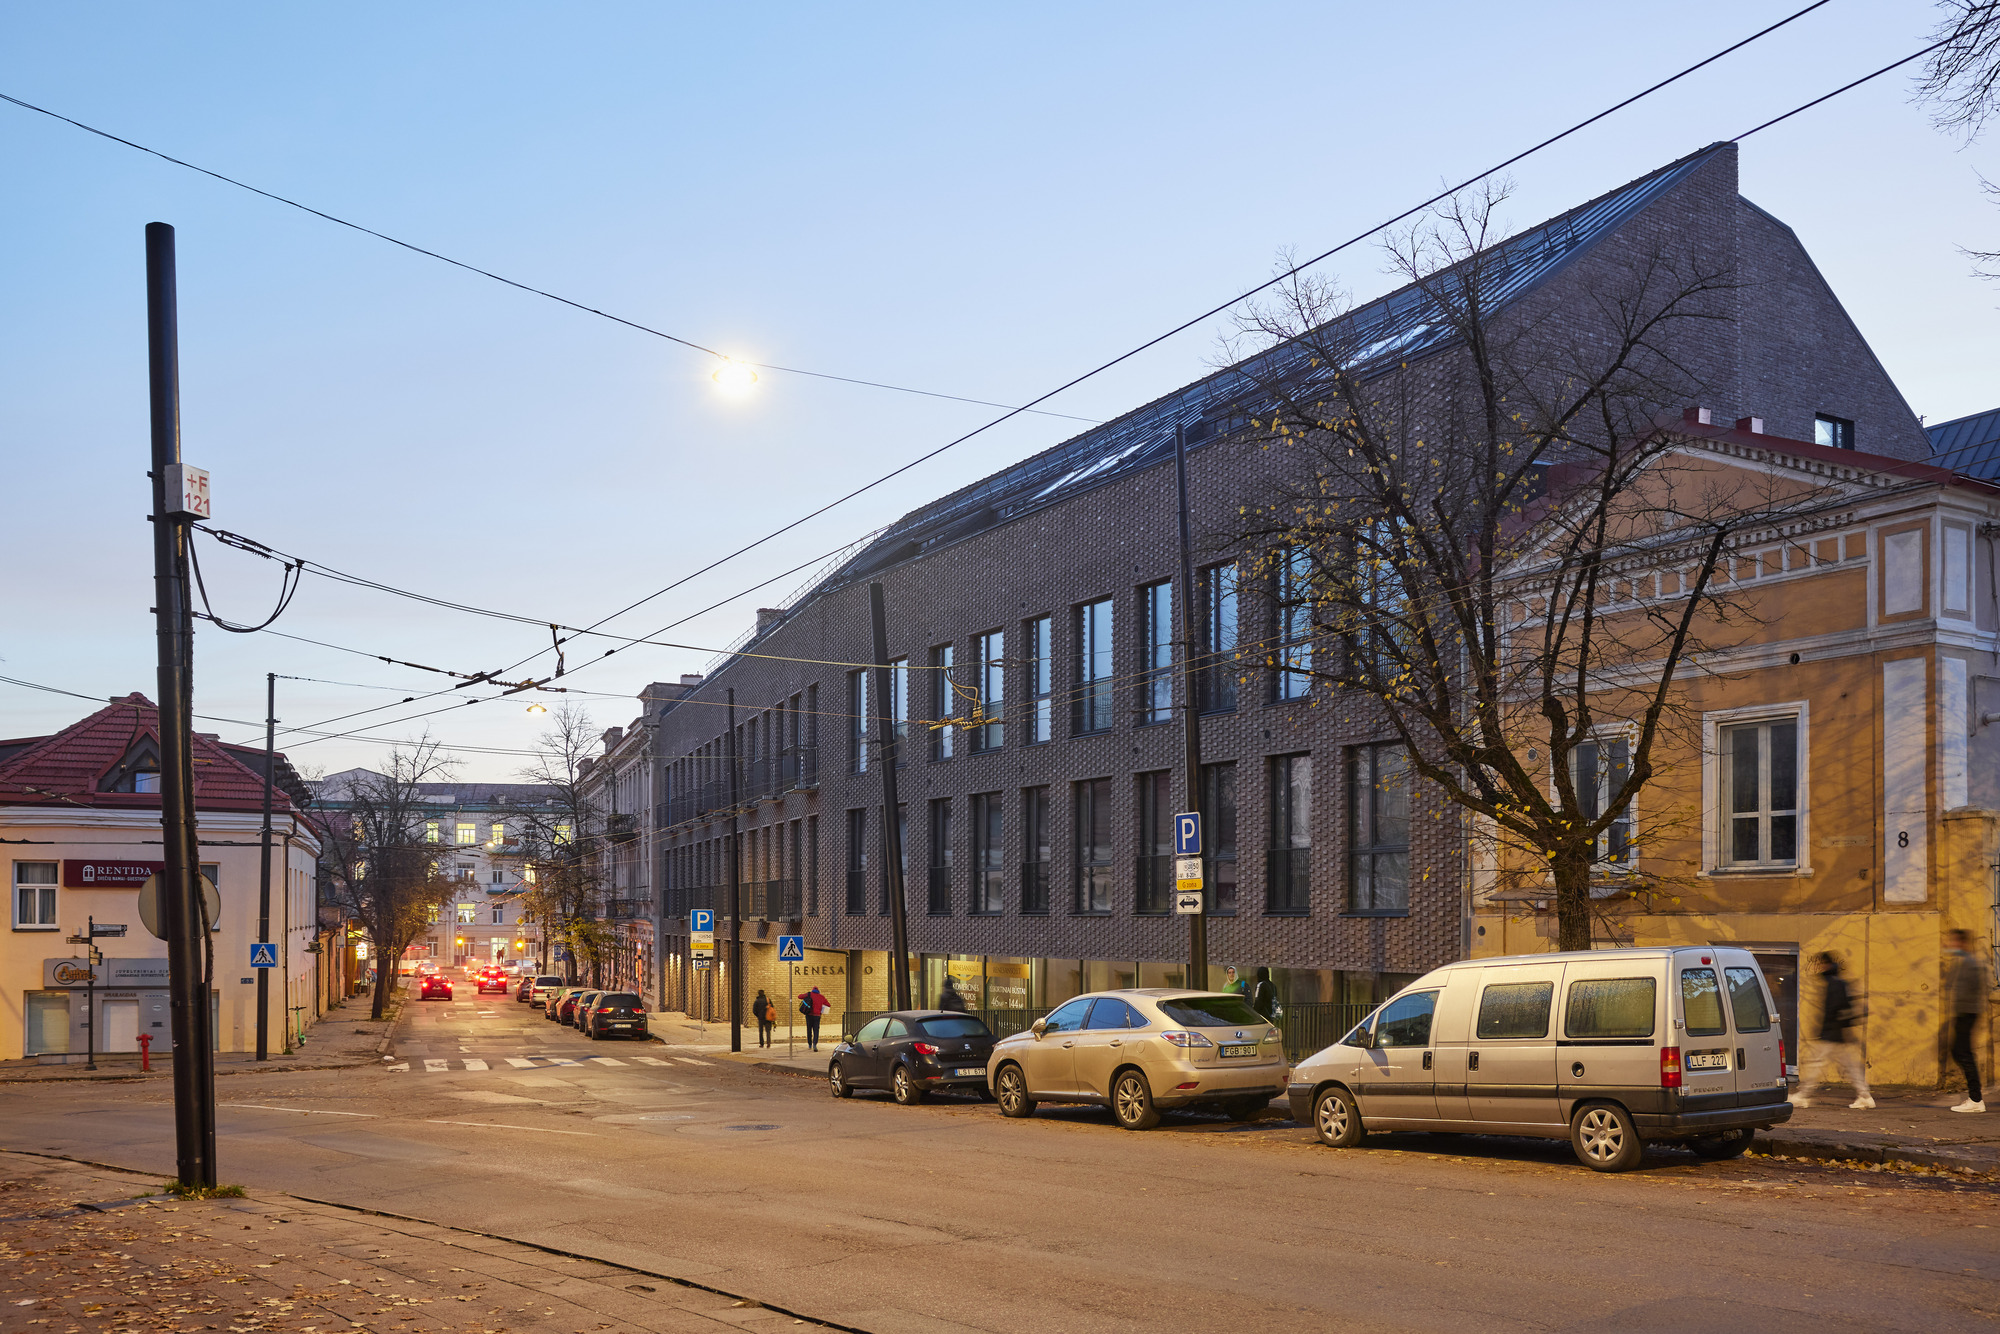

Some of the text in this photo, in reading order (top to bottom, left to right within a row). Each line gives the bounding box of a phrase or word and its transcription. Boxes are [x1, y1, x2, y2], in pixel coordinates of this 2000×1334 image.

[184, 492, 210, 516] 121
[1181, 818, 1195, 850] P
[1898, 831, 1909, 848] 8
[97, 866, 152, 875] RENTIDA
[697, 912, 710, 930] P
[1224, 1046, 1255, 1055] FGB 901
[1690, 1055, 1724, 1067] LLF 227
